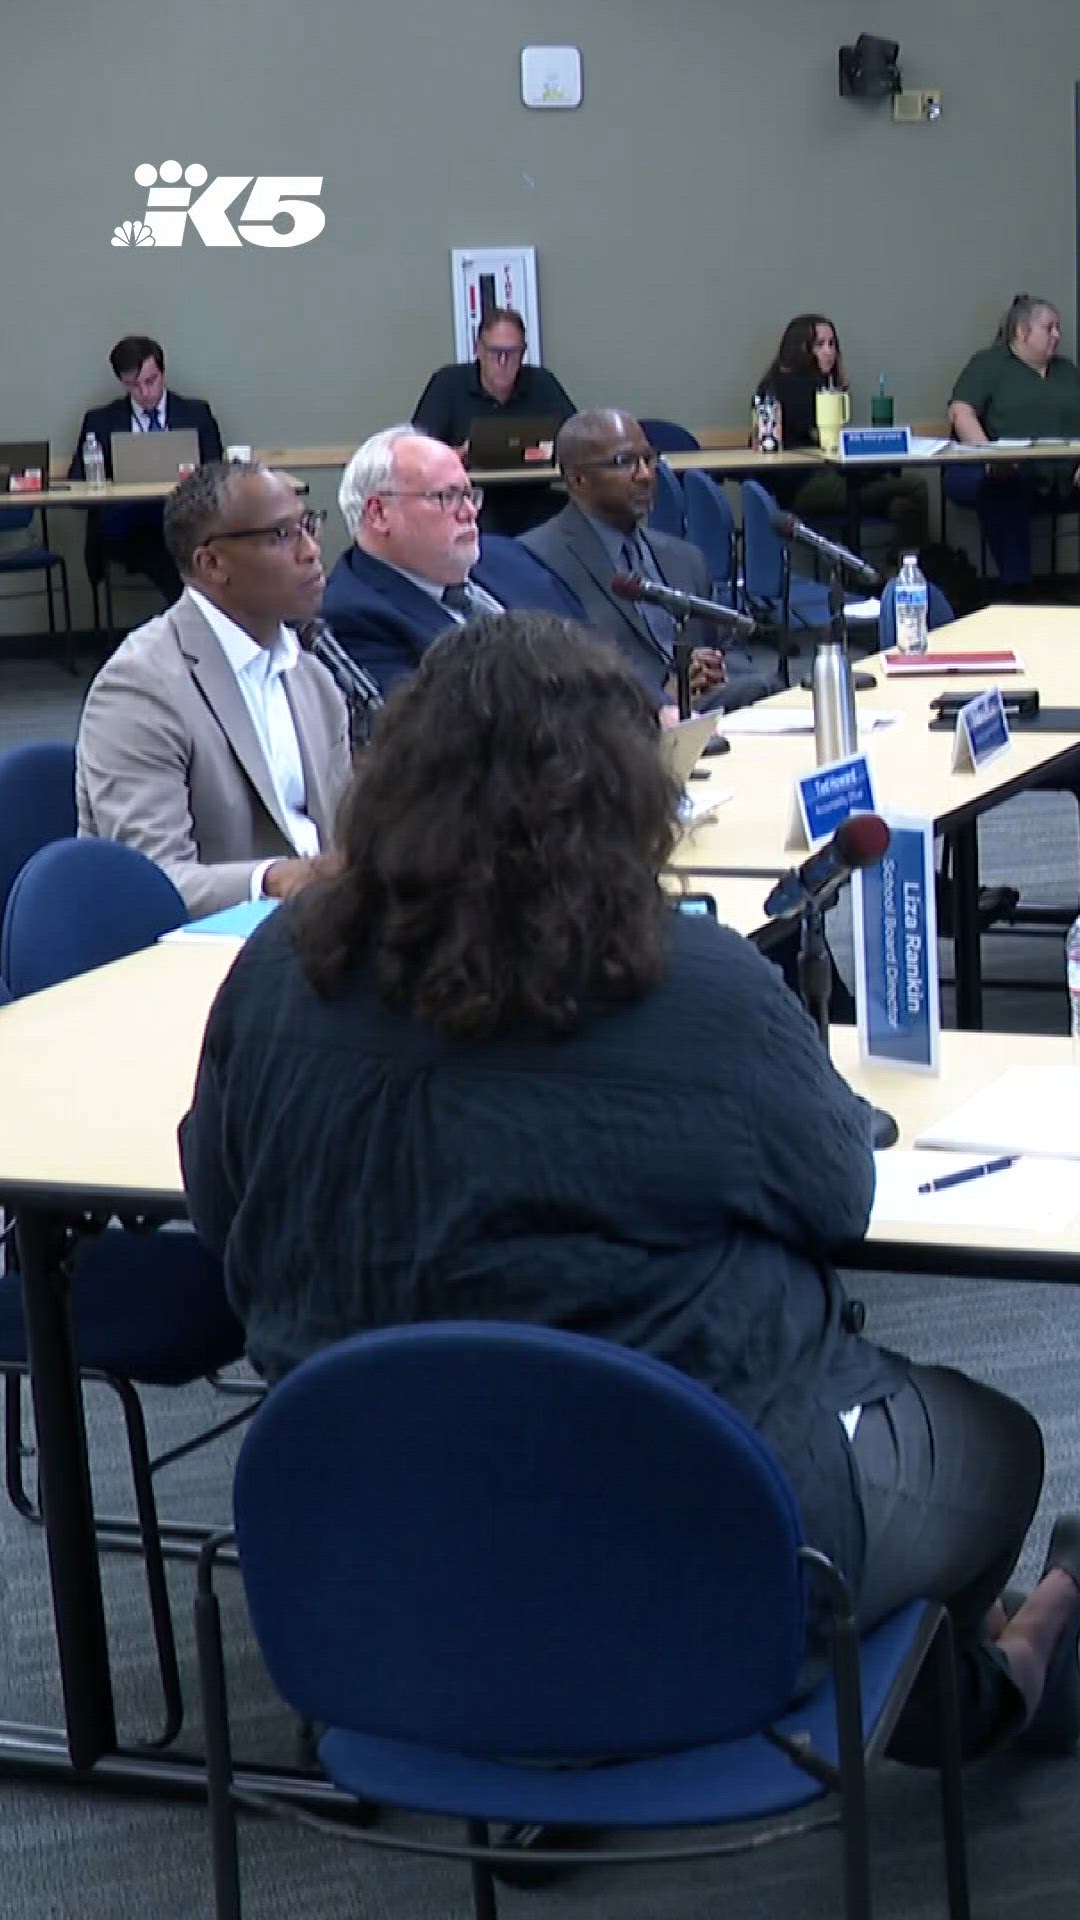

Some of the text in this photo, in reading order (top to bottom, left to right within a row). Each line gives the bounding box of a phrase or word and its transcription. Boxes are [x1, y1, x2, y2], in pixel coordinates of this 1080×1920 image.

[882, 859, 899, 1029] School Board Director
[903, 881, 924, 1013] Liza Rankin
